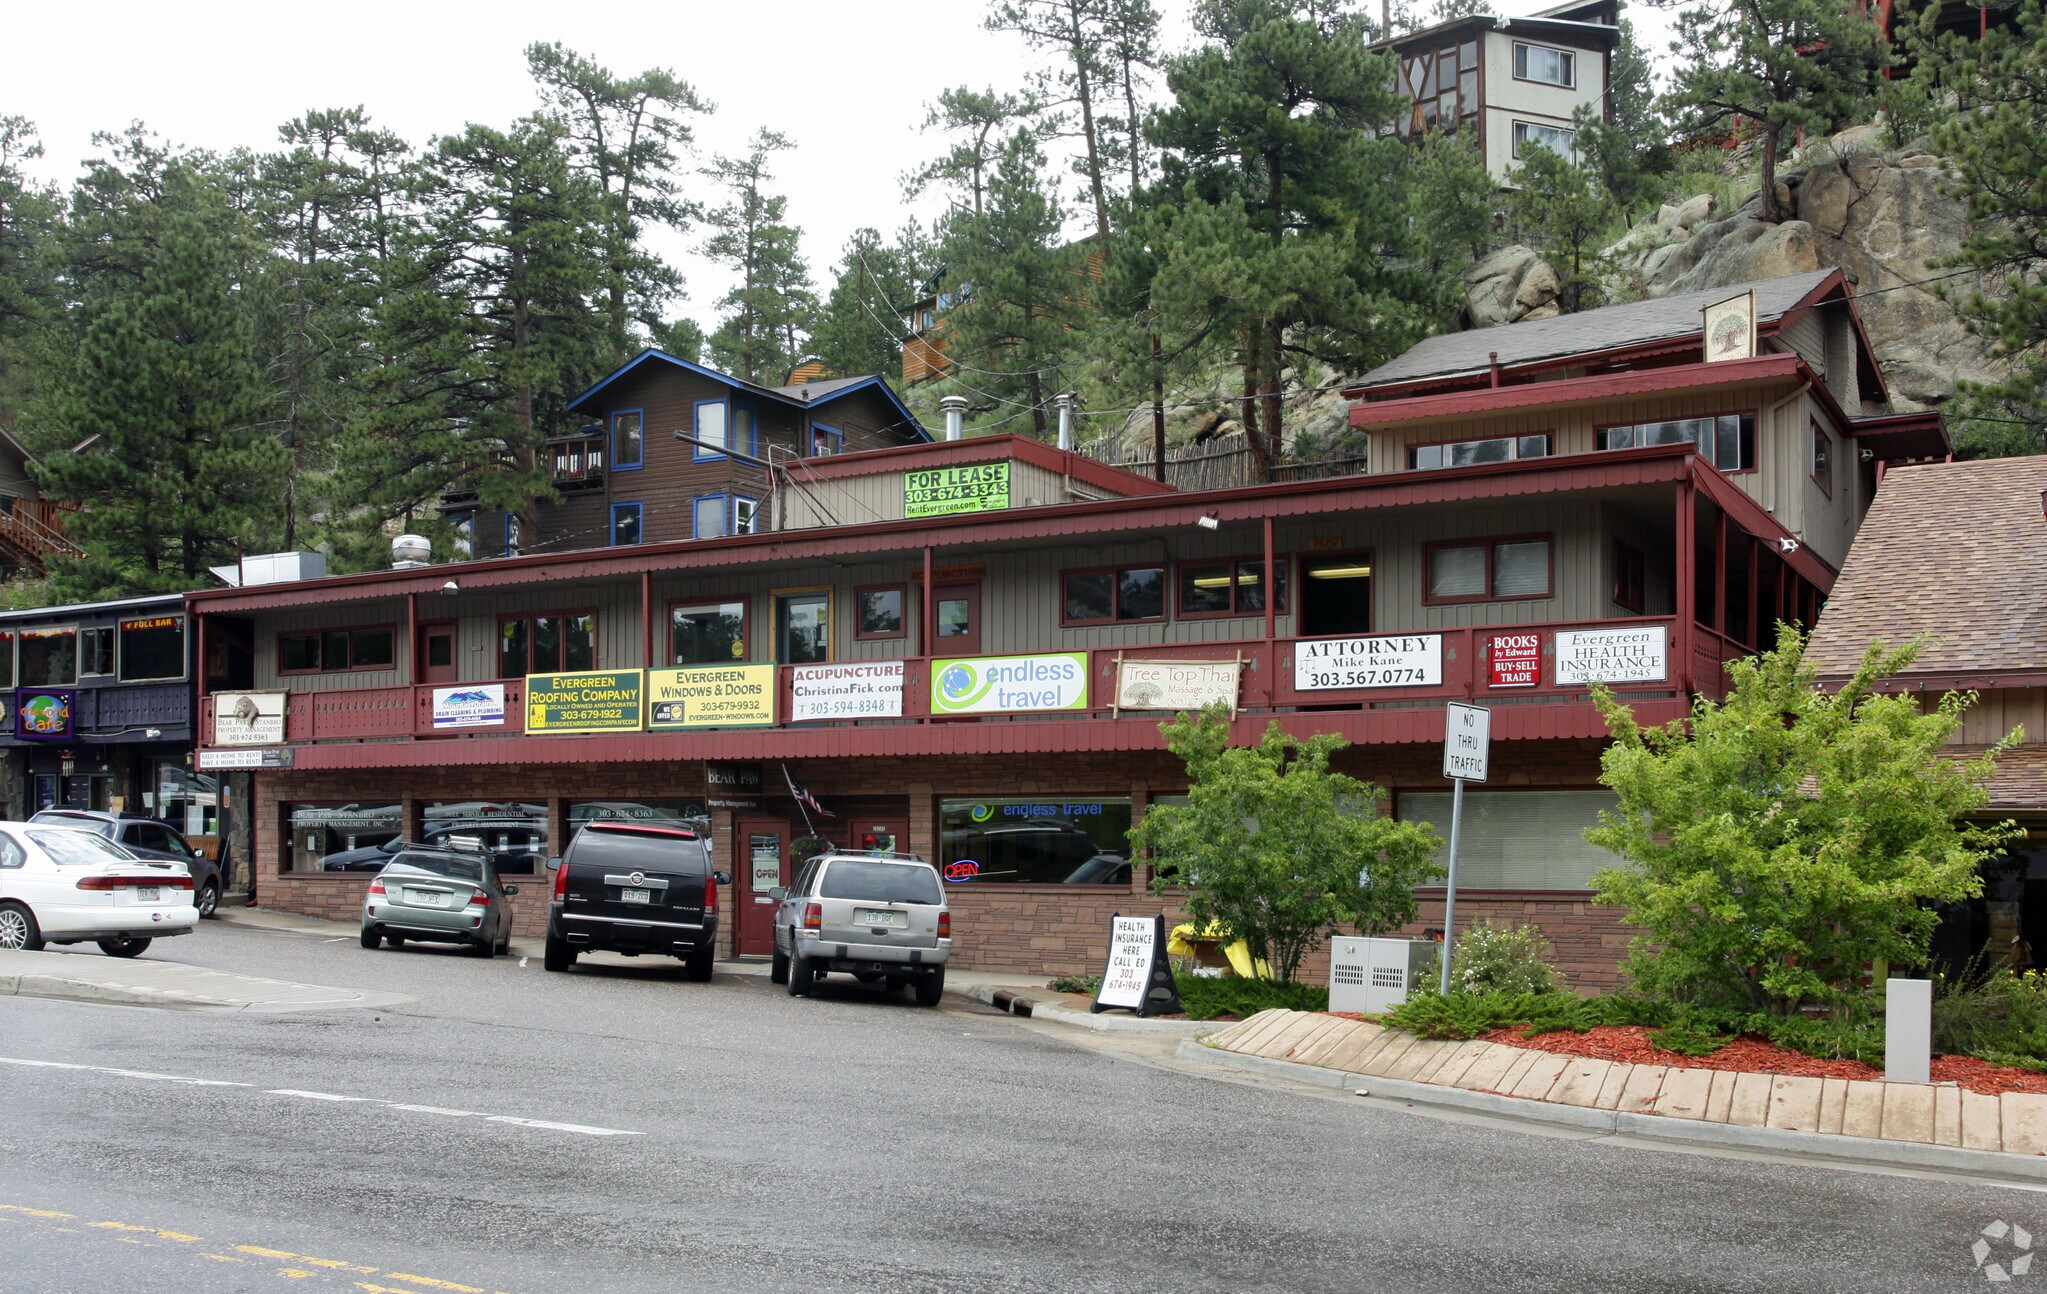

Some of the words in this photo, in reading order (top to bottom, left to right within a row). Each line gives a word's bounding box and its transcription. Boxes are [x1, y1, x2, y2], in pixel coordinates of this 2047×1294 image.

[908, 472, 942, 490] FOR
[948, 465, 1004, 486] LEASE
[905, 482, 1008, 503] 303-674-3343
[907, 501, 976, 514] RentEvergreen.com
[134, 620, 153, 628] FULL
[156, 618, 172, 626] BAR
[1494, 635, 1538, 649] BOOKS
[1572, 634, 1650, 646] Evergreen
[1306, 637, 1431, 658] ATTORNEY
[1495, 650, 1503, 658] by
[1505, 648, 1536, 656] Edward
[1575, 645, 1646, 659] HEALTH
[1332, 658, 1365, 668] Mike
[1369, 656, 1403, 666] Kane
[1560, 656, 1661, 671] INSURANCE
[676, 671, 745, 684] EVERGREEN
[795, 666, 903, 681] ACUPUNCTURE
[986, 660, 1074, 683] endless
[1126, 667, 1160, 680] Tree
[1165, 667, 1197, 685] Top
[1200, 666, 1235, 682] Thai
[1310, 668, 1425, 687] 303.567.0774
[1501, 672, 1532, 682] TRADE
[552, 677, 616, 689] EVERGREEN
[530, 692, 578, 703] ROOFING
[582, 690, 637, 701] COMPANY
[660, 686, 712, 698] WINDOWS
[714, 684, 722, 696] &
[725, 684, 762, 695] DOORS
[998, 684, 1061, 708] travel
[1168, 685, 1203, 697] Massage
[1207, 685, 1214, 693] &
[1216, 686, 1233, 696] Spa
[20, 705, 38, 716] one
[700, 700, 760, 711] 303-679-9932
[810, 700, 884, 714] 303-594-8348
[560, 710, 622, 720] 303-679-1922
[1464, 713, 1474, 727] NO
[25, 717, 64, 732] cafe
[1458, 734, 1478, 750] THRU
[1451, 756, 1482, 772] TRAFFIC
[708, 768, 735, 784] BEAR
[741, 768, 758, 784] PAW
[338, 811, 375, 819] STANBRO
[1003, 803, 1056, 816] endless
[1063, 802, 1102, 815] travel
[756, 869, 778, 878] OPEN
[944, 864, 978, 878] OPEN
[1119, 922, 1145, 932] HEALTH
[1115, 934, 1152, 944] INSURANCE
[1123, 946, 1140, 955] HERE
[1114, 957, 1131, 966] CALL
[1136, 958, 1145, 967] ED
[1120, 969, 1133, 978] 303
[1109, 980, 1141, 990] 674-1945
